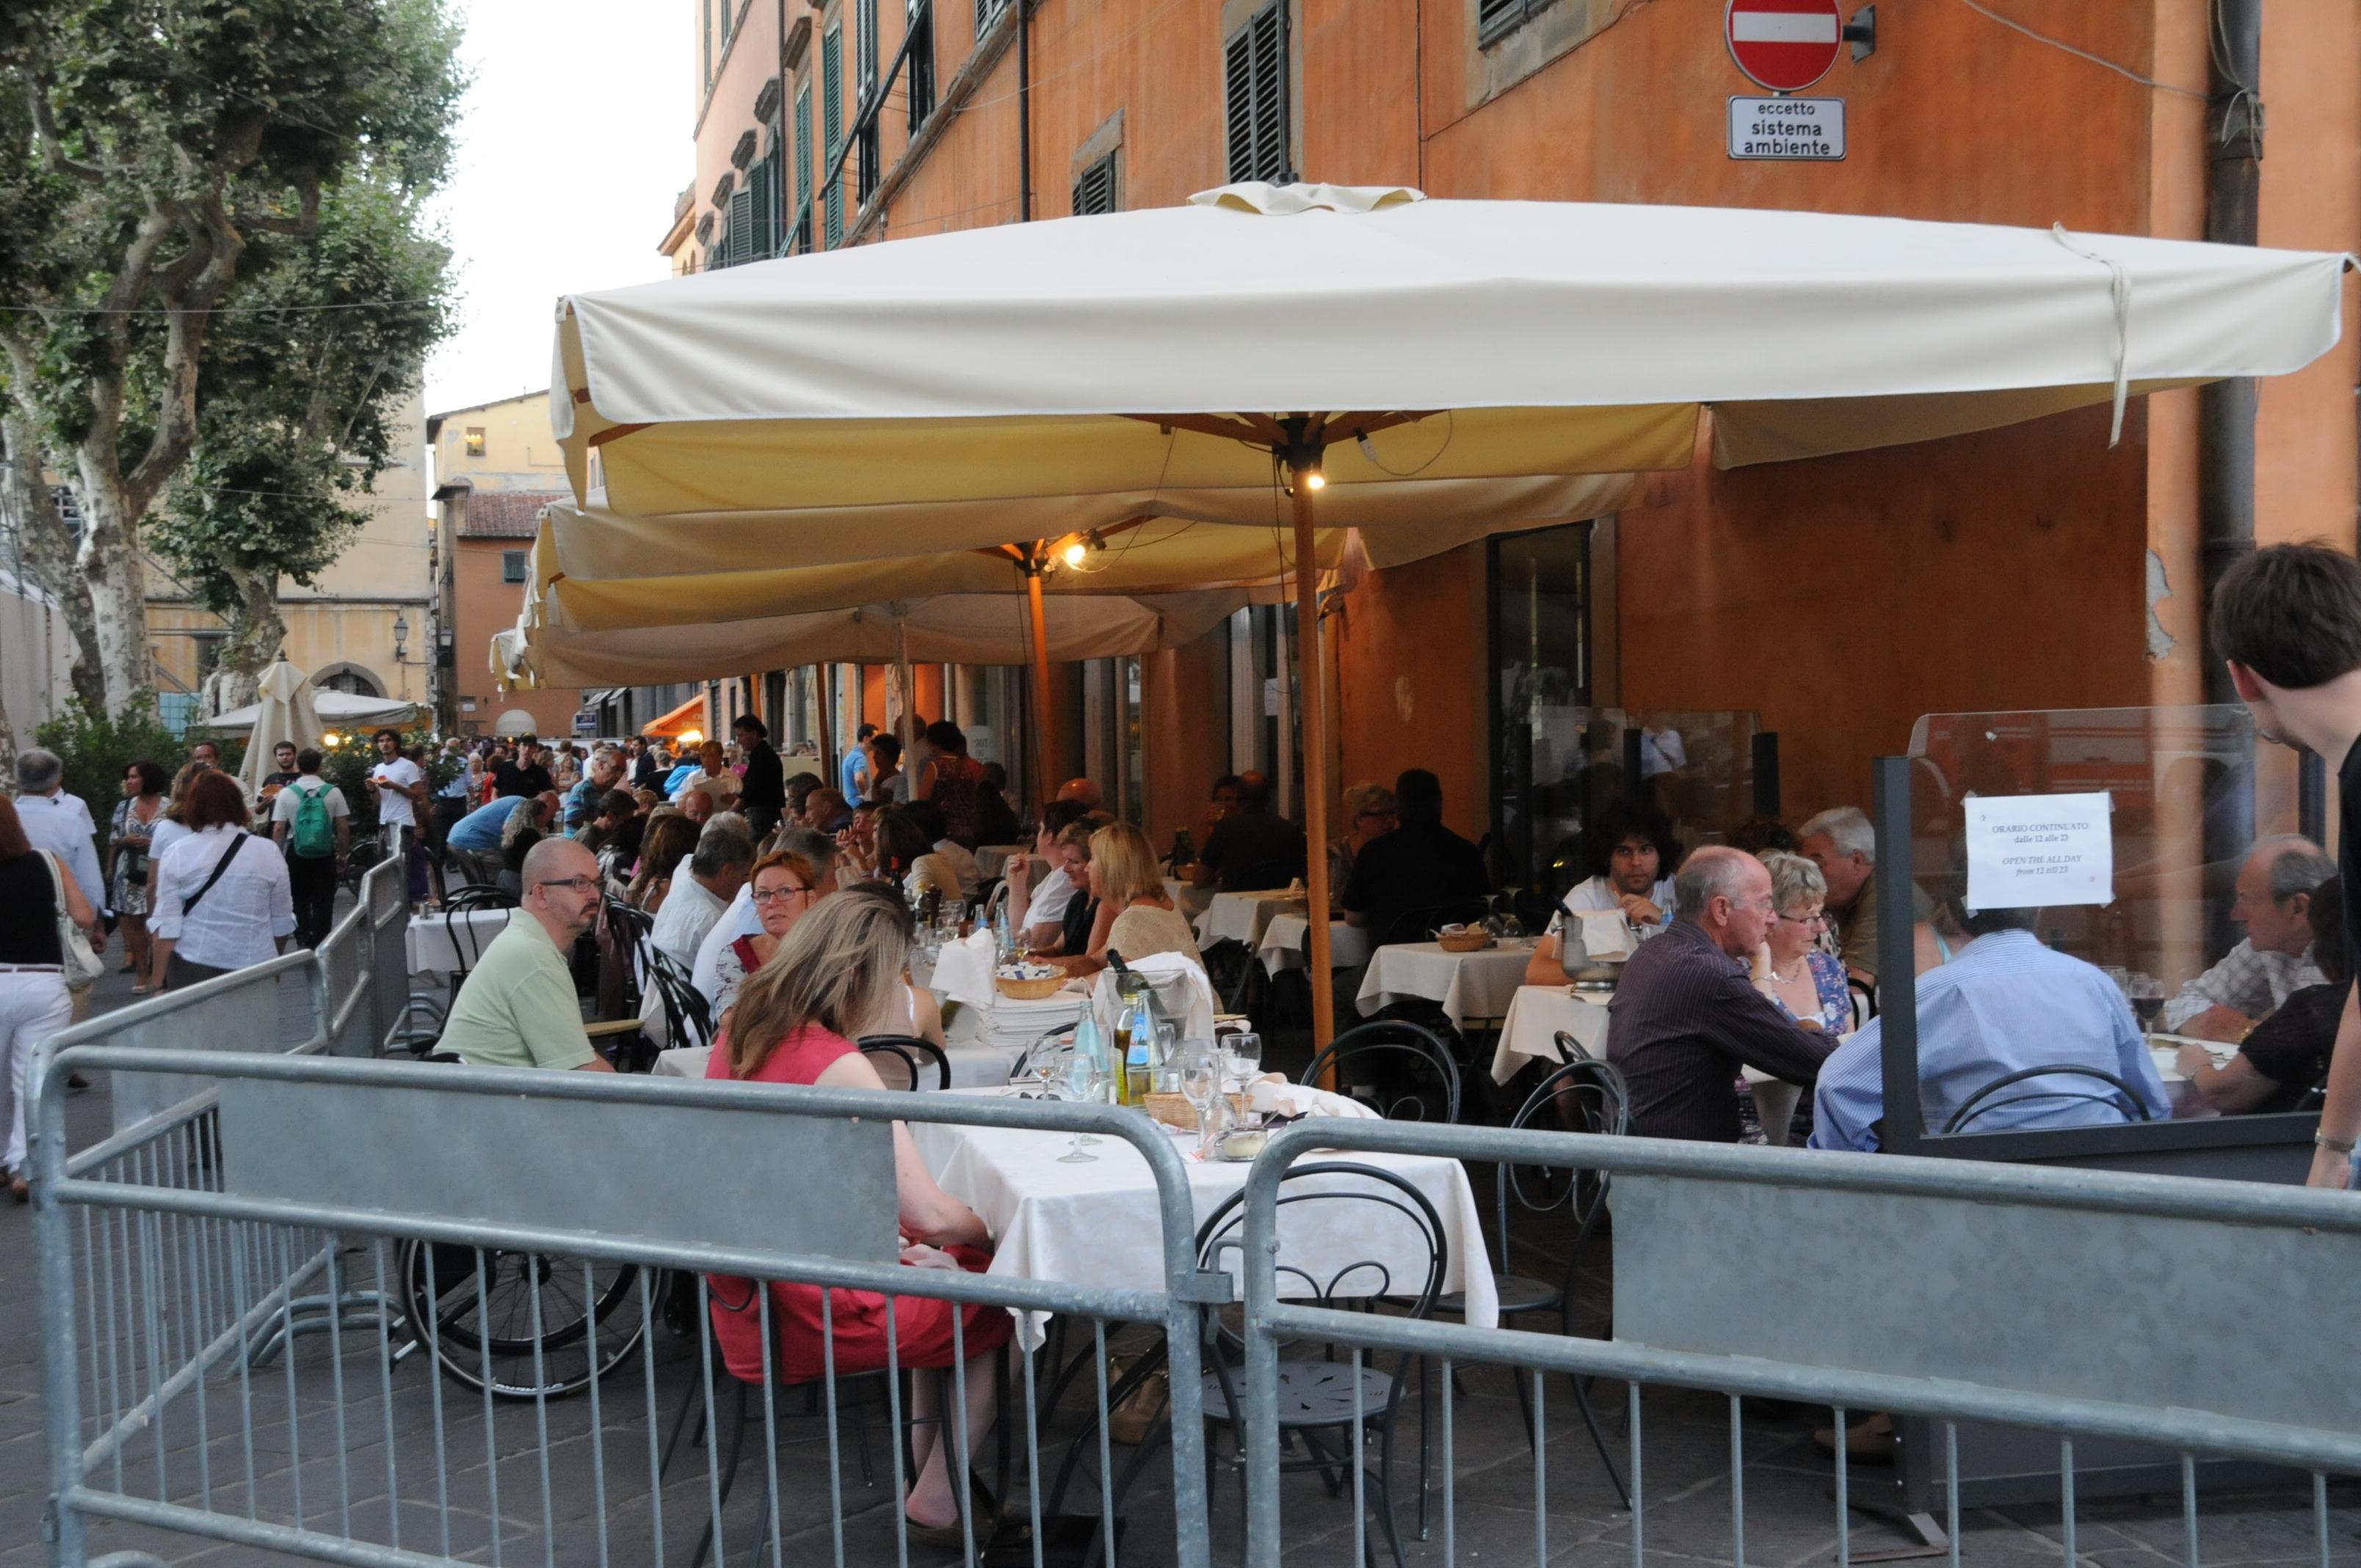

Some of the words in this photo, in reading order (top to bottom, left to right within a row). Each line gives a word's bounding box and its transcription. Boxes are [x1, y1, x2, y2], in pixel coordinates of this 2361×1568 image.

[1758, 102, 1816, 115] eccetto
[1752, 120, 1822, 137] sistema
[1744, 139, 1830, 155] ambiente
[1992, 824, 2028, 833] ORARIO
[2029, 822, 2089, 832] CONTINUATO
[2014, 835, 2033, 843] dalle
[2045, 834, 2059, 842] alle
[2002, 857, 2026, 865] OPEN
[2028, 856, 2045, 864] THE
[2046, 855, 2062, 863] ALL
[2064, 854, 2083, 863] DAY
[2015, 868, 2034, 877] from
